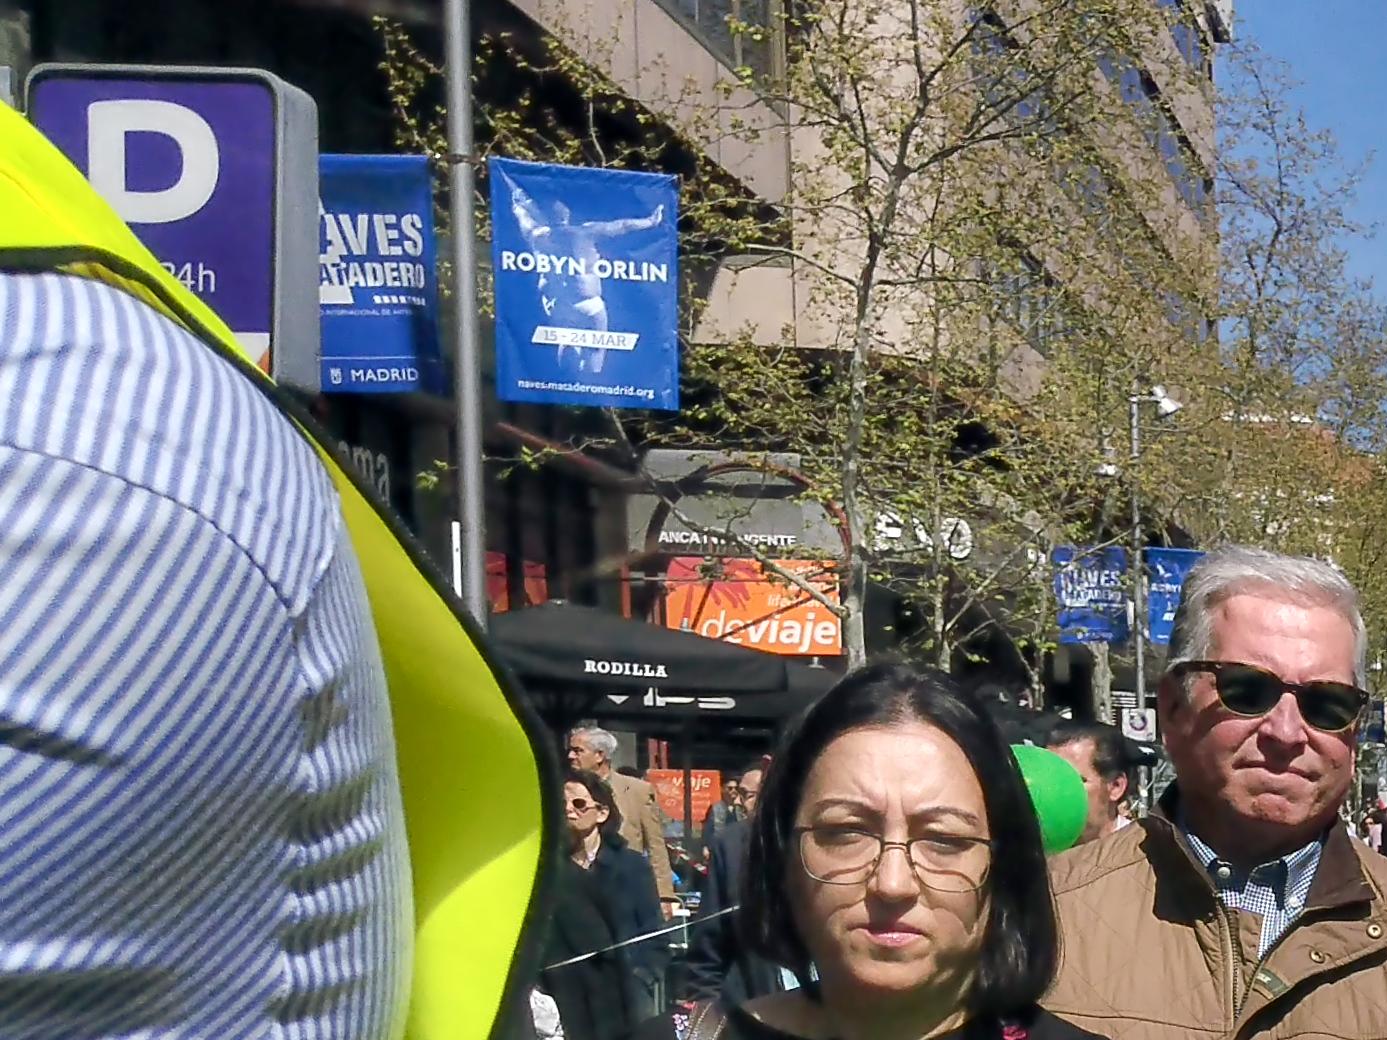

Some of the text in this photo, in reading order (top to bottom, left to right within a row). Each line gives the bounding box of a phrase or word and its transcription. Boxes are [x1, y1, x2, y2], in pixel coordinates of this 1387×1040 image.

[320, 214, 425, 257] AVES
[502, 251, 668, 283] ROBYN ORLIN
[543, 329, 557, 342] 15
[571, 331, 587, 343] 24
[592, 333, 627, 348] MAR
[351, 368, 419, 382] MADRID
[658, 531, 701, 544] ANCA
[584, 660, 668, 678] RODILLA
